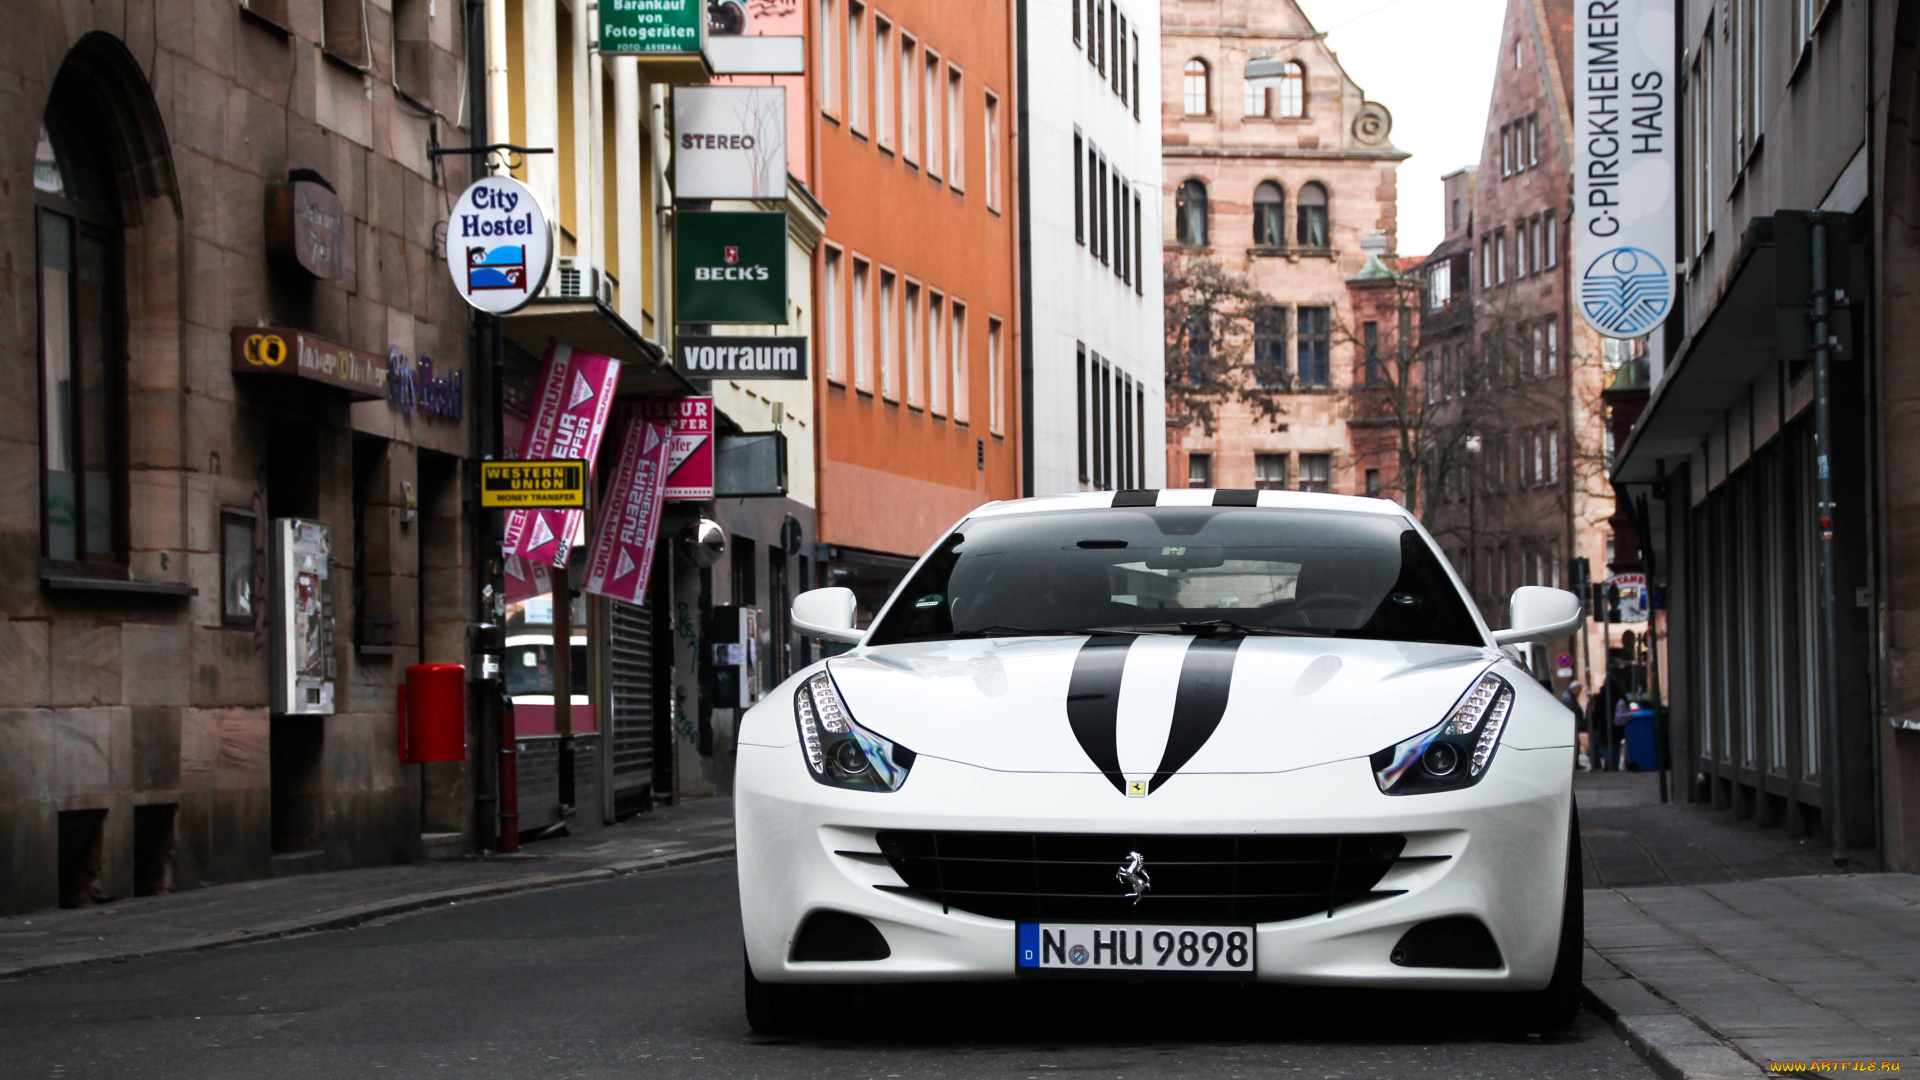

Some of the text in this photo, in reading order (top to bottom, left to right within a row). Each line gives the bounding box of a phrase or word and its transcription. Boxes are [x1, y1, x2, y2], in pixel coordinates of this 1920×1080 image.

[638, 13, 662, 23] von
[605, 23, 695, 38] Fotogeräten
[1632, 71, 1663, 154] HAUS
[681, 133, 755, 149] STEREO
[471, 186, 519, 213] City
[461, 213, 533, 237] Hostel
[695, 264, 769, 281] BECK'S
[684, 346, 798, 371] vorraum
[487, 468, 564, 479] WESTERN
[511, 479, 564, 489] UNION
[531, 493, 576, 501] TRANSFER
[1025, 950, 1033, 960] D
[1042, 928, 1249, 967] N HU 9898
